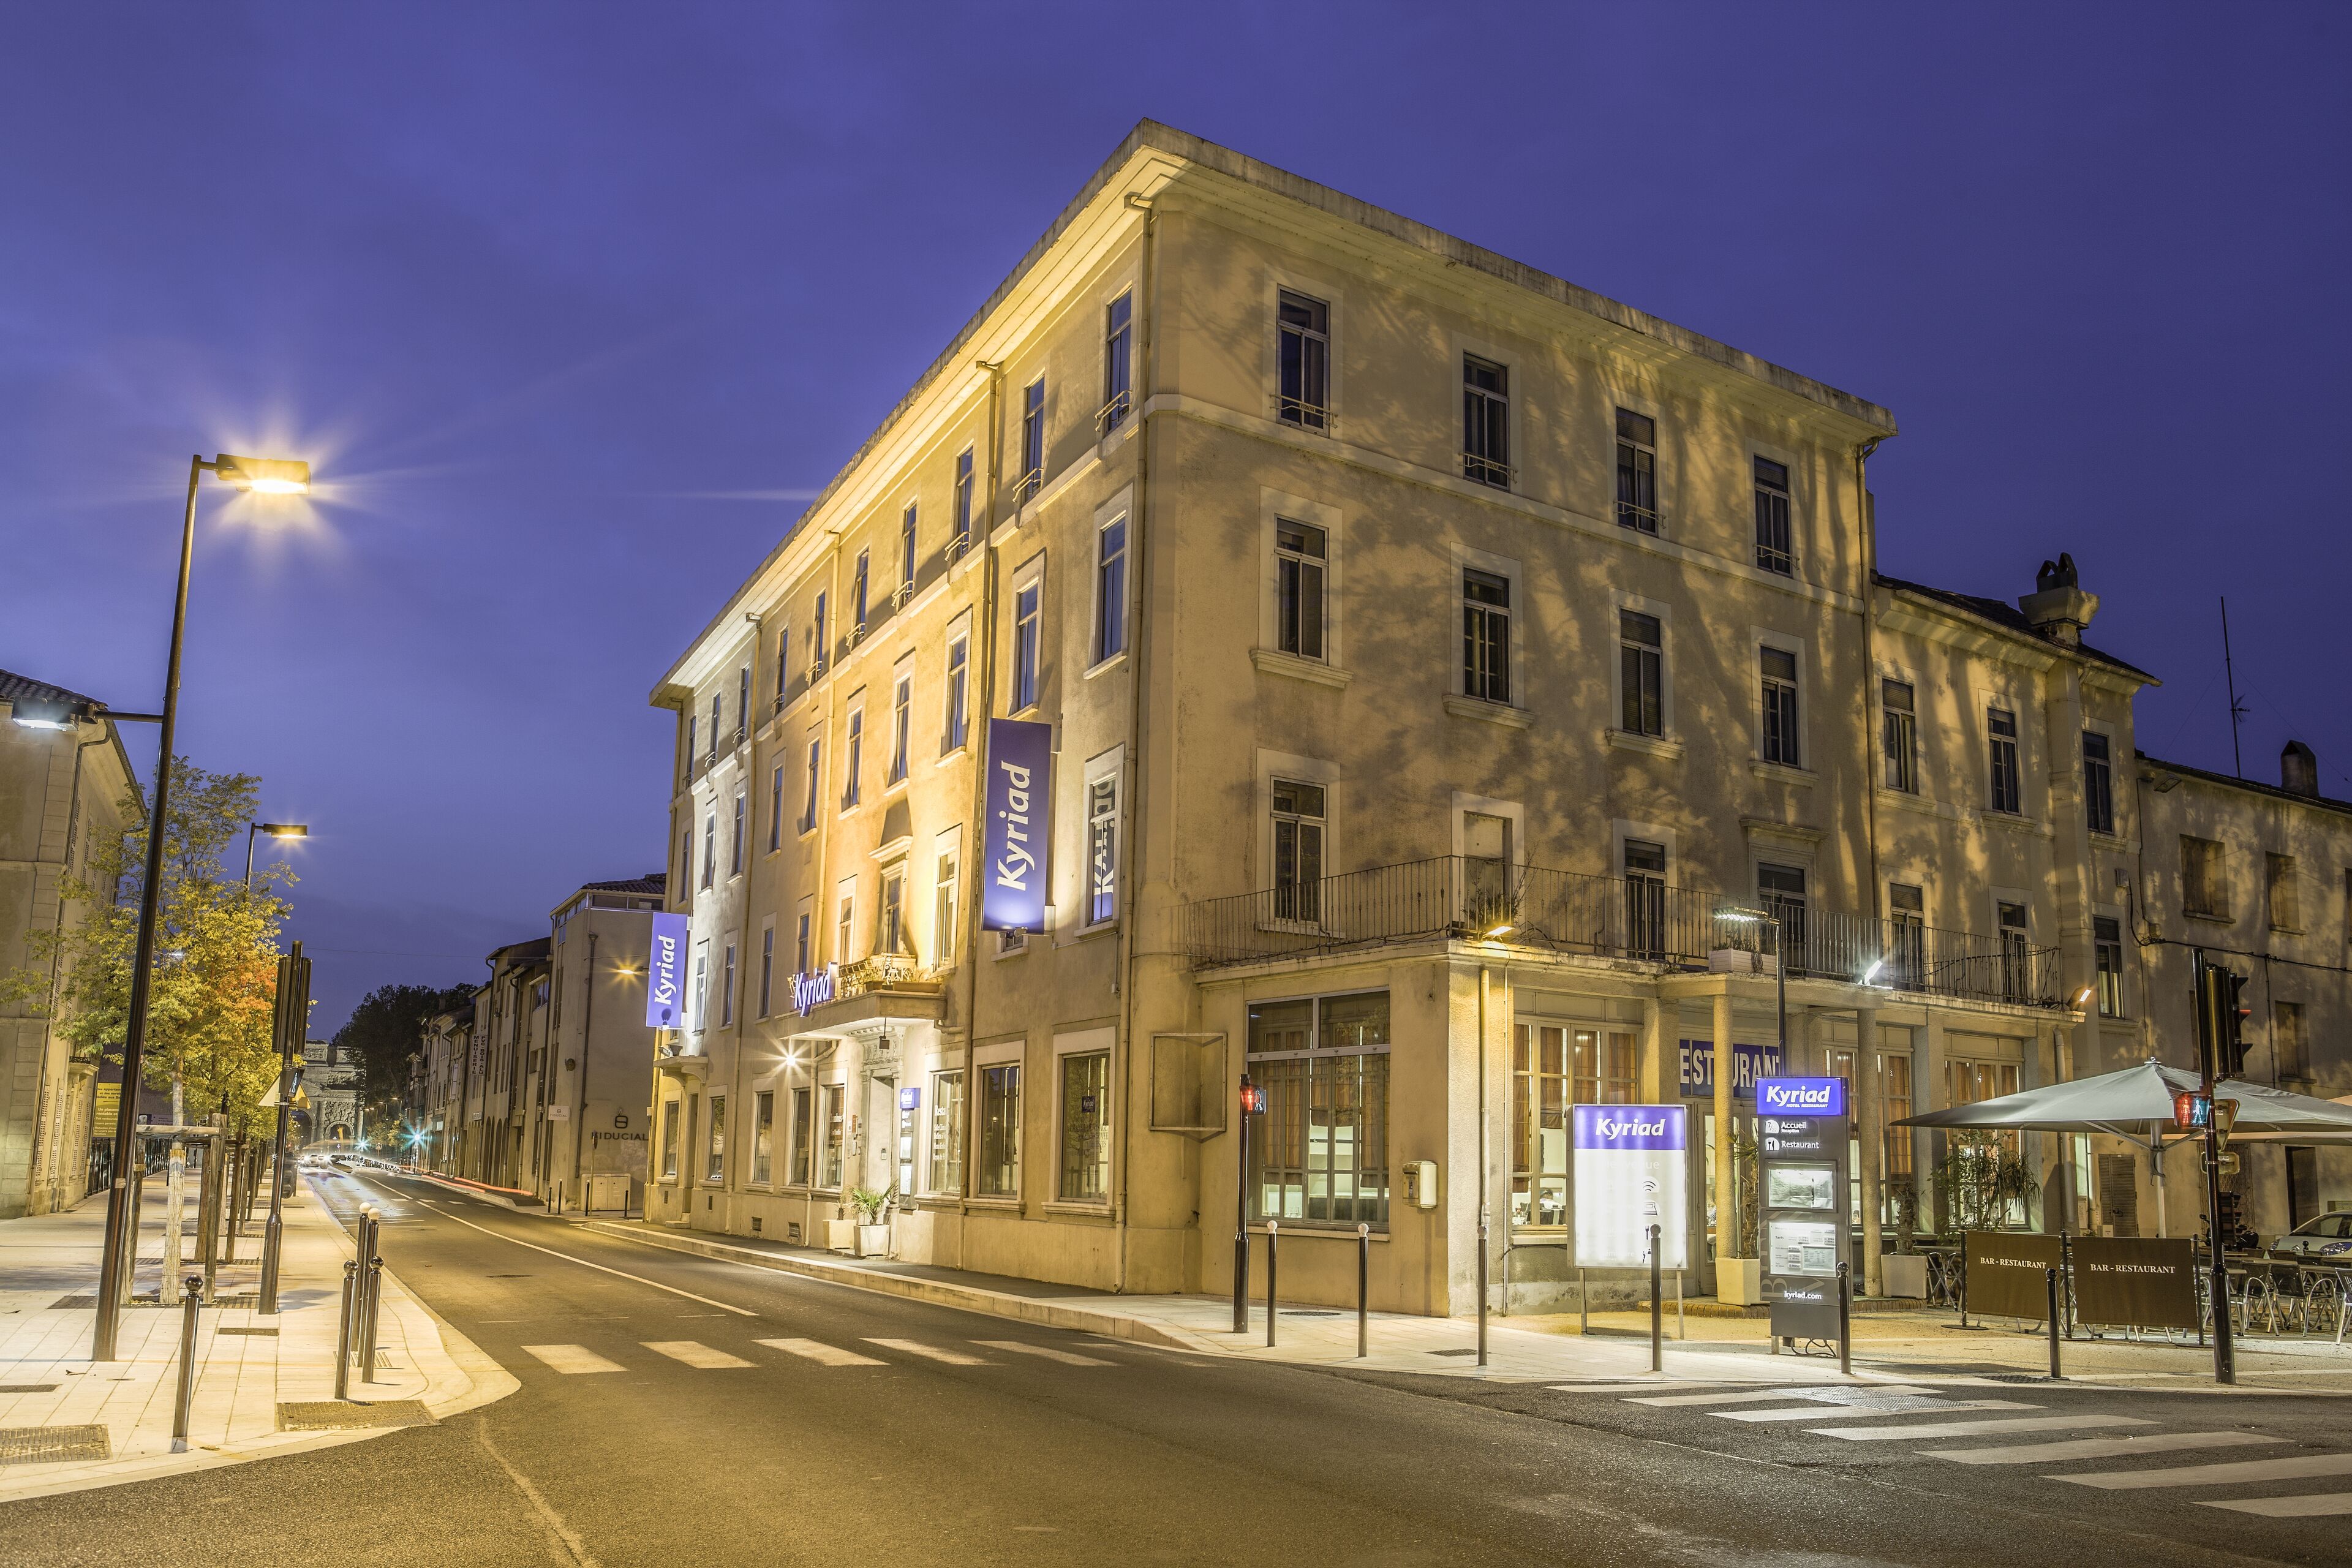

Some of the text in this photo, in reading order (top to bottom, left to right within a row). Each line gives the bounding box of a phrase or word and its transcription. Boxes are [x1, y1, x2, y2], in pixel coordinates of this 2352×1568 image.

[997, 760, 1035, 891] Kyriad
[654, 935, 677, 1005] Kyriad
[794, 962, 832, 1017] Kyriad
[1766, 1085, 1831, 1107] Kyriad
[1596, 1118, 1666, 1140] Kyriad
[1781, 1140, 1819, 1149] Restaurant
[2000, 1258, 2046, 1269] RESTAURANT
[2116, 1265, 2175, 1274] RESTAURANT
[1784, 1291, 1822, 1300] kyriad.com
